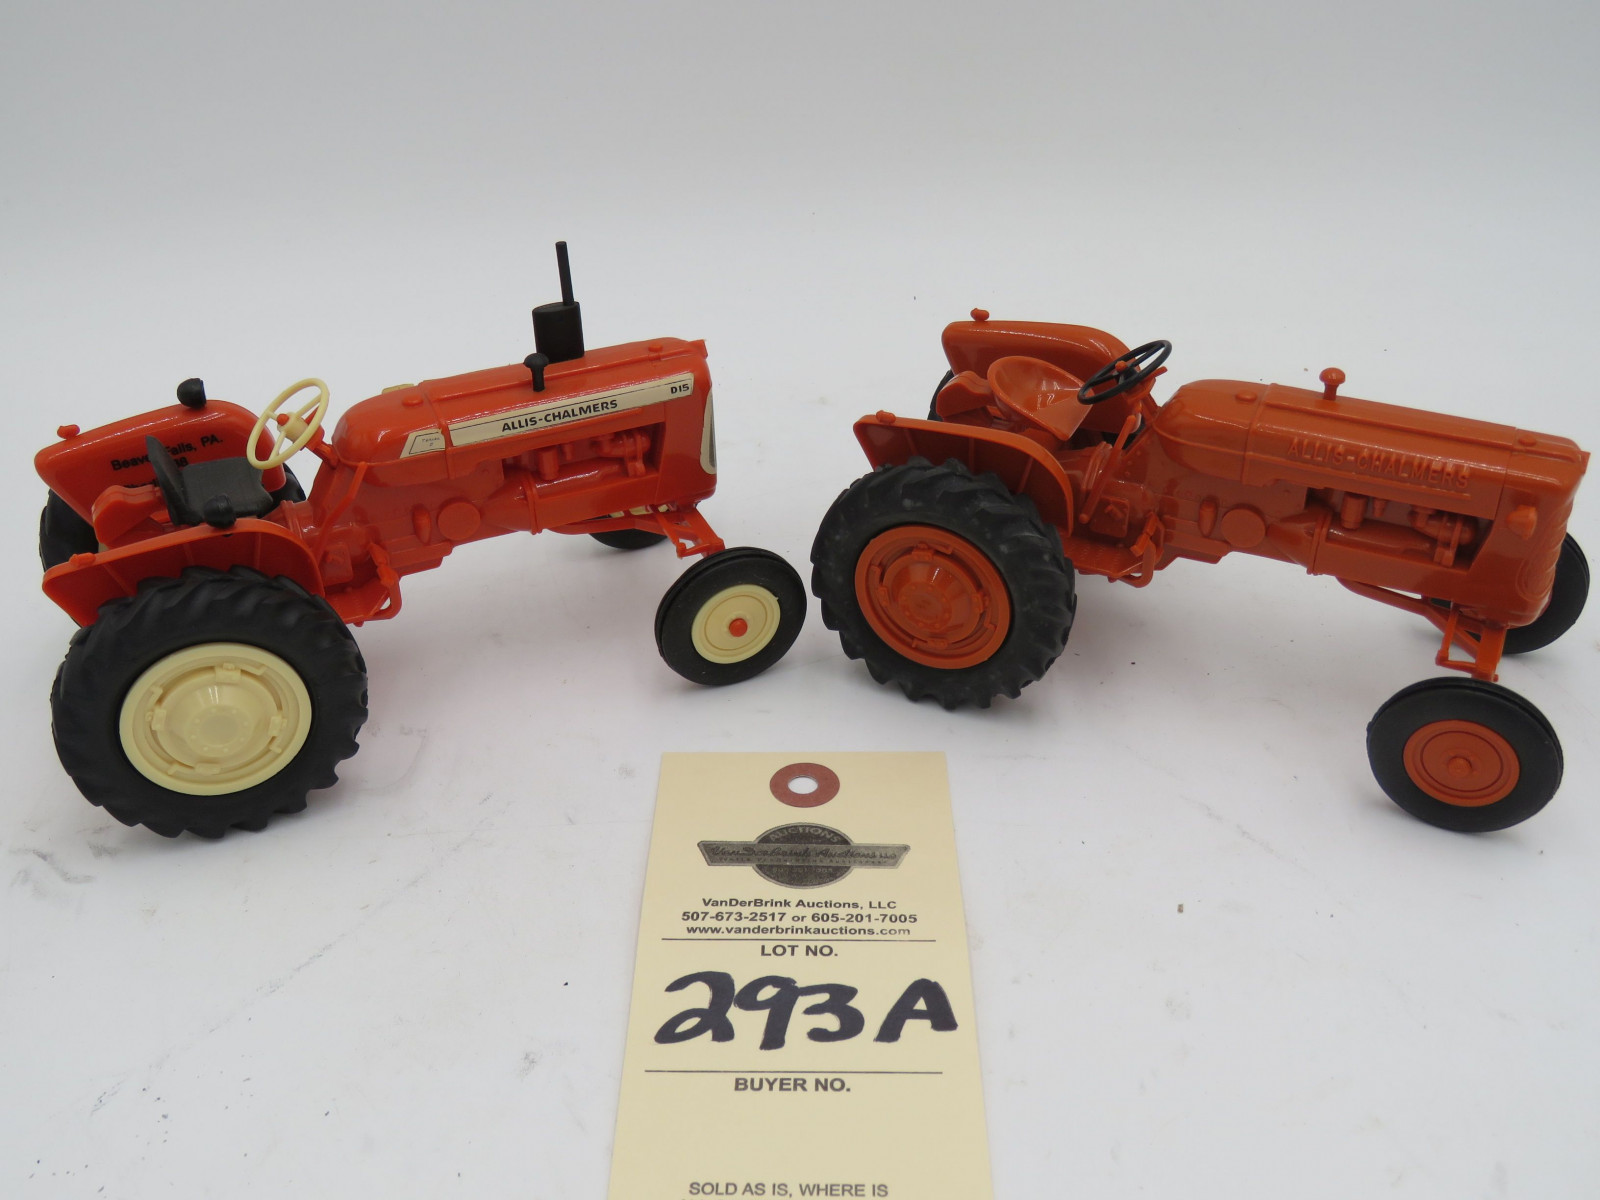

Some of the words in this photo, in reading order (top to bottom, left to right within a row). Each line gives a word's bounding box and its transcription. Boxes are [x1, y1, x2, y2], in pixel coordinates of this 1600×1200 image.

[670, 383, 690, 395] D15
[501, 399, 618, 432] ALLIS-CHALMERS
[110, 454, 150, 471] Beave
[200, 434, 223, 447] PA.
[1288, 437, 1470, 489] ALLIS-CHALMERS
[769, 826, 841, 843] AUCTIONS
[702, 898, 791, 908] VanDerBrink
[795, 899, 863, 910] Auctions,
[868, 900, 897, 910] LLC
[681, 911, 786, 922] 507-673-2517
[791, 915, 807, 923] or
[811, 912, 918, 924] 605-201-7005
[686, 925, 911, 936] www.vanderbrinkauctions.com
[760, 944, 799, 957] LOT
[805, 944, 838, 957] NO.
[734, 1077, 807, 1092] BUYER
[814, 1077, 851, 1092] NO.
[689, 1182, 738, 1196] SOLD
[742, 1182, 766, 1197] AS
[772, 1183, 793, 1198] IS,
[799, 1183, 866, 1197] WHERE
[872, 1184, 889, 1197] IS
